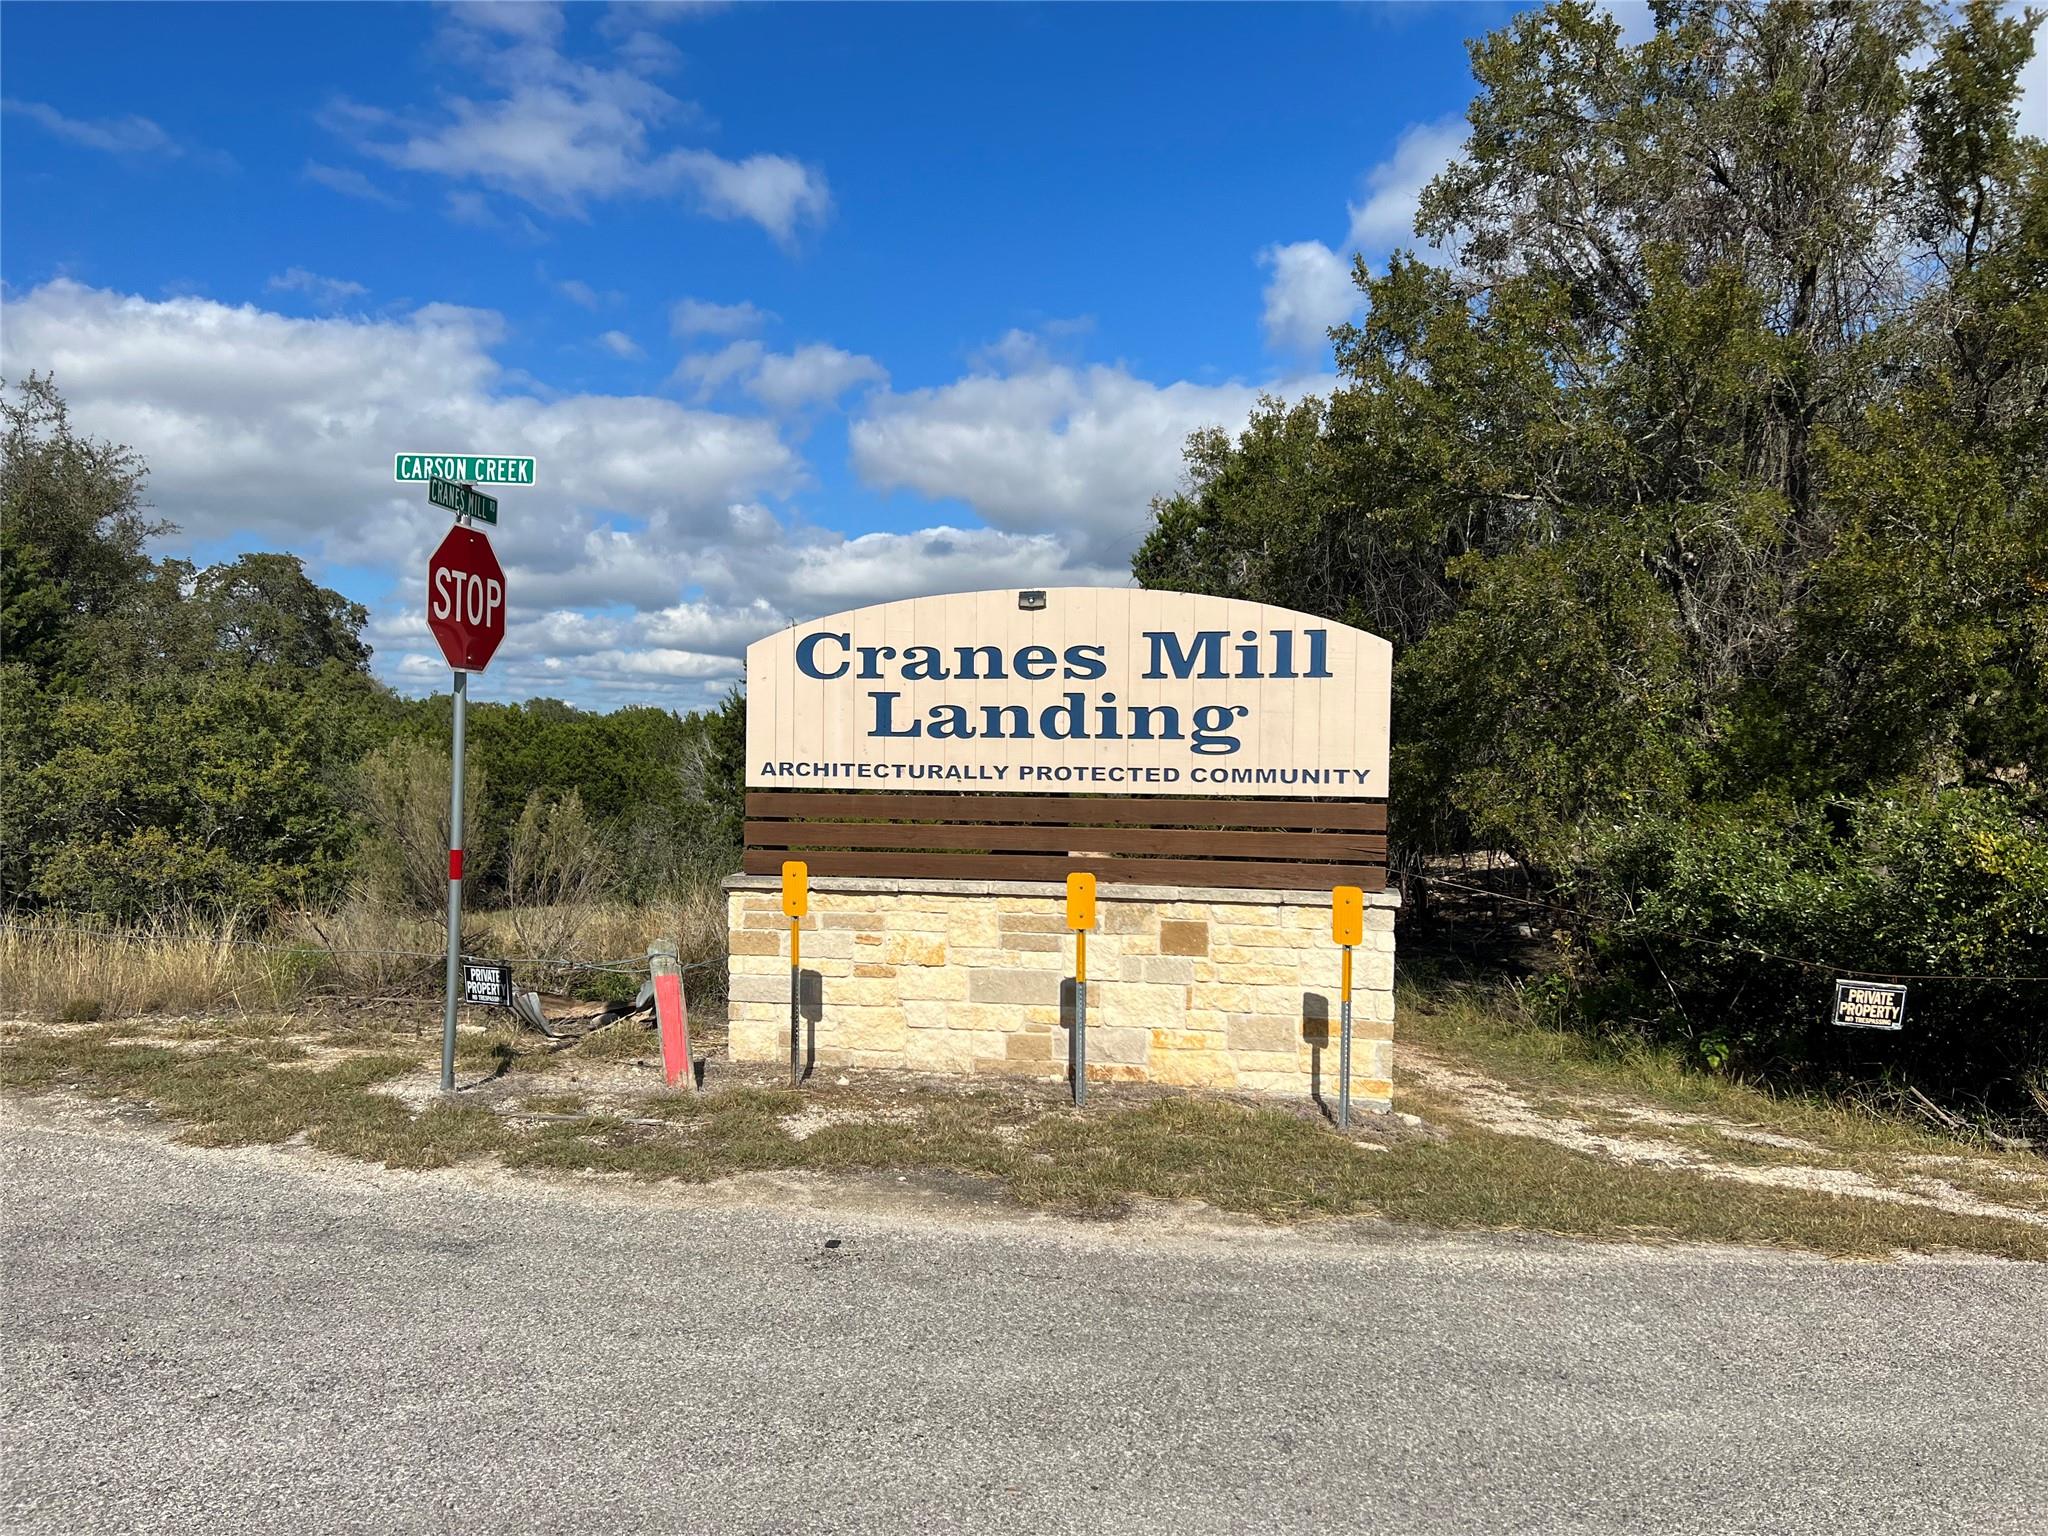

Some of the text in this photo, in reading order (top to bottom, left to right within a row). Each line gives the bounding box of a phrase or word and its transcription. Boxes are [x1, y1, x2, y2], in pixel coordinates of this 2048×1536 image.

[402, 457, 528, 482] CARSON CREEK
[431, 479, 465, 510] CRANES
[468, 493, 487, 519] MILL
[433, 567, 501, 627] STOP
[794, 630, 1333, 680] Cranes Mill
[868, 692, 1248, 755] Landing
[761, 762, 1370, 784] ARCHITECTURALLY PROTECTED COMMUNITY
[471, 968, 500, 982] PRIVATE
[467, 981, 506, 996] PROPERTY
[1848, 989, 1895, 1006] PRIVATE
[1840, 1001, 1900, 1020] PROPERTY
[1855, 1016, 1892, 1025] TRESPASSING
